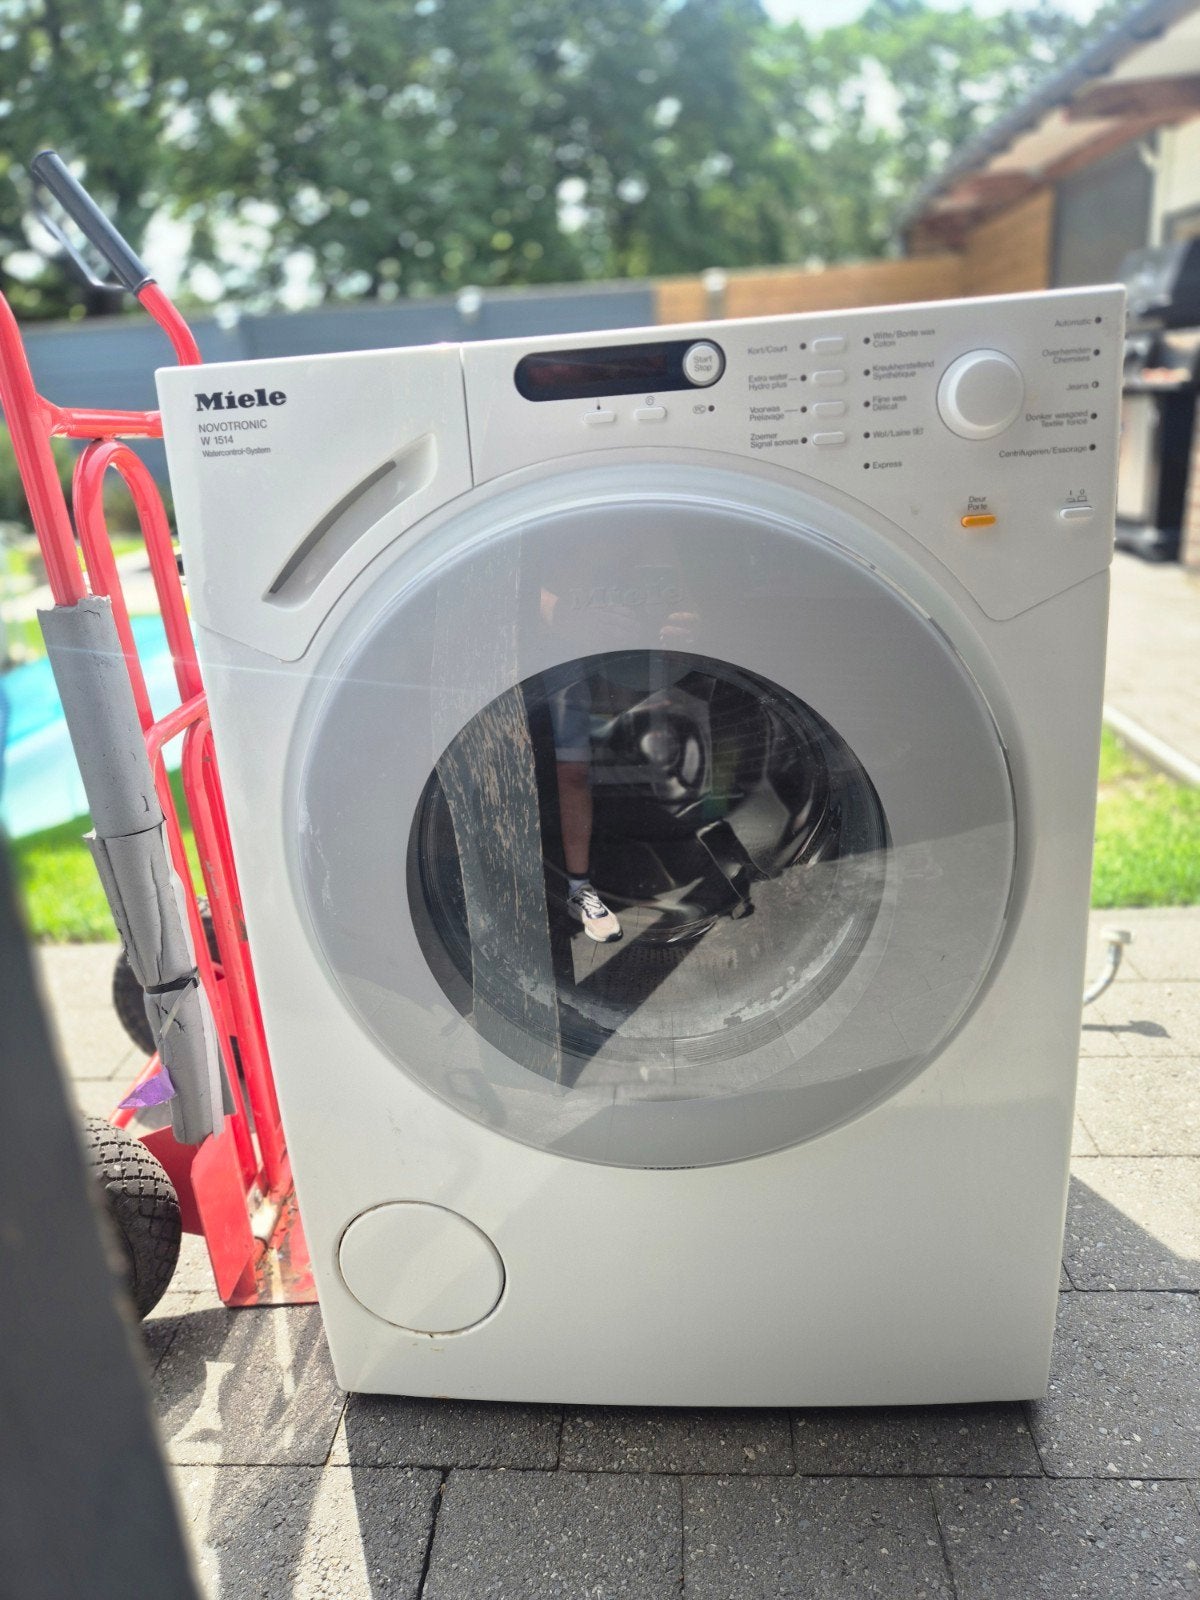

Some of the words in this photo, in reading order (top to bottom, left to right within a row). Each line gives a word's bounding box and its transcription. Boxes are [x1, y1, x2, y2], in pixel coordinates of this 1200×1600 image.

[1055, 319, 1092, 327] Automatic
[747, 345, 788, 354] Kort/Court
[693, 354, 712, 363] Start
[694, 364, 712, 372] Stop
[749, 375, 767, 383] Extra
[749, 383, 770, 391] Hydro
[772, 382, 788, 390] plus
[194, 388, 287, 411] Miele
[750, 406, 780, 414] Voorwas
[1026, 413, 1052, 422] Donker
[1055, 410, 1088, 419] wasgoed
[198, 419, 268, 433] NOVOTRONIC
[200, 437, 210, 446] W
[214, 435, 234, 445] 1514
[750, 433, 777, 441] Zoemer
[750, 441, 772, 449] Signal
[202, 447, 271, 458] Watercontrol-System
[999, 446, 1087, 458] Centrifugeren/Essorage
[873, 461, 903, 470] Express
[967, 503, 988, 511] Porte
